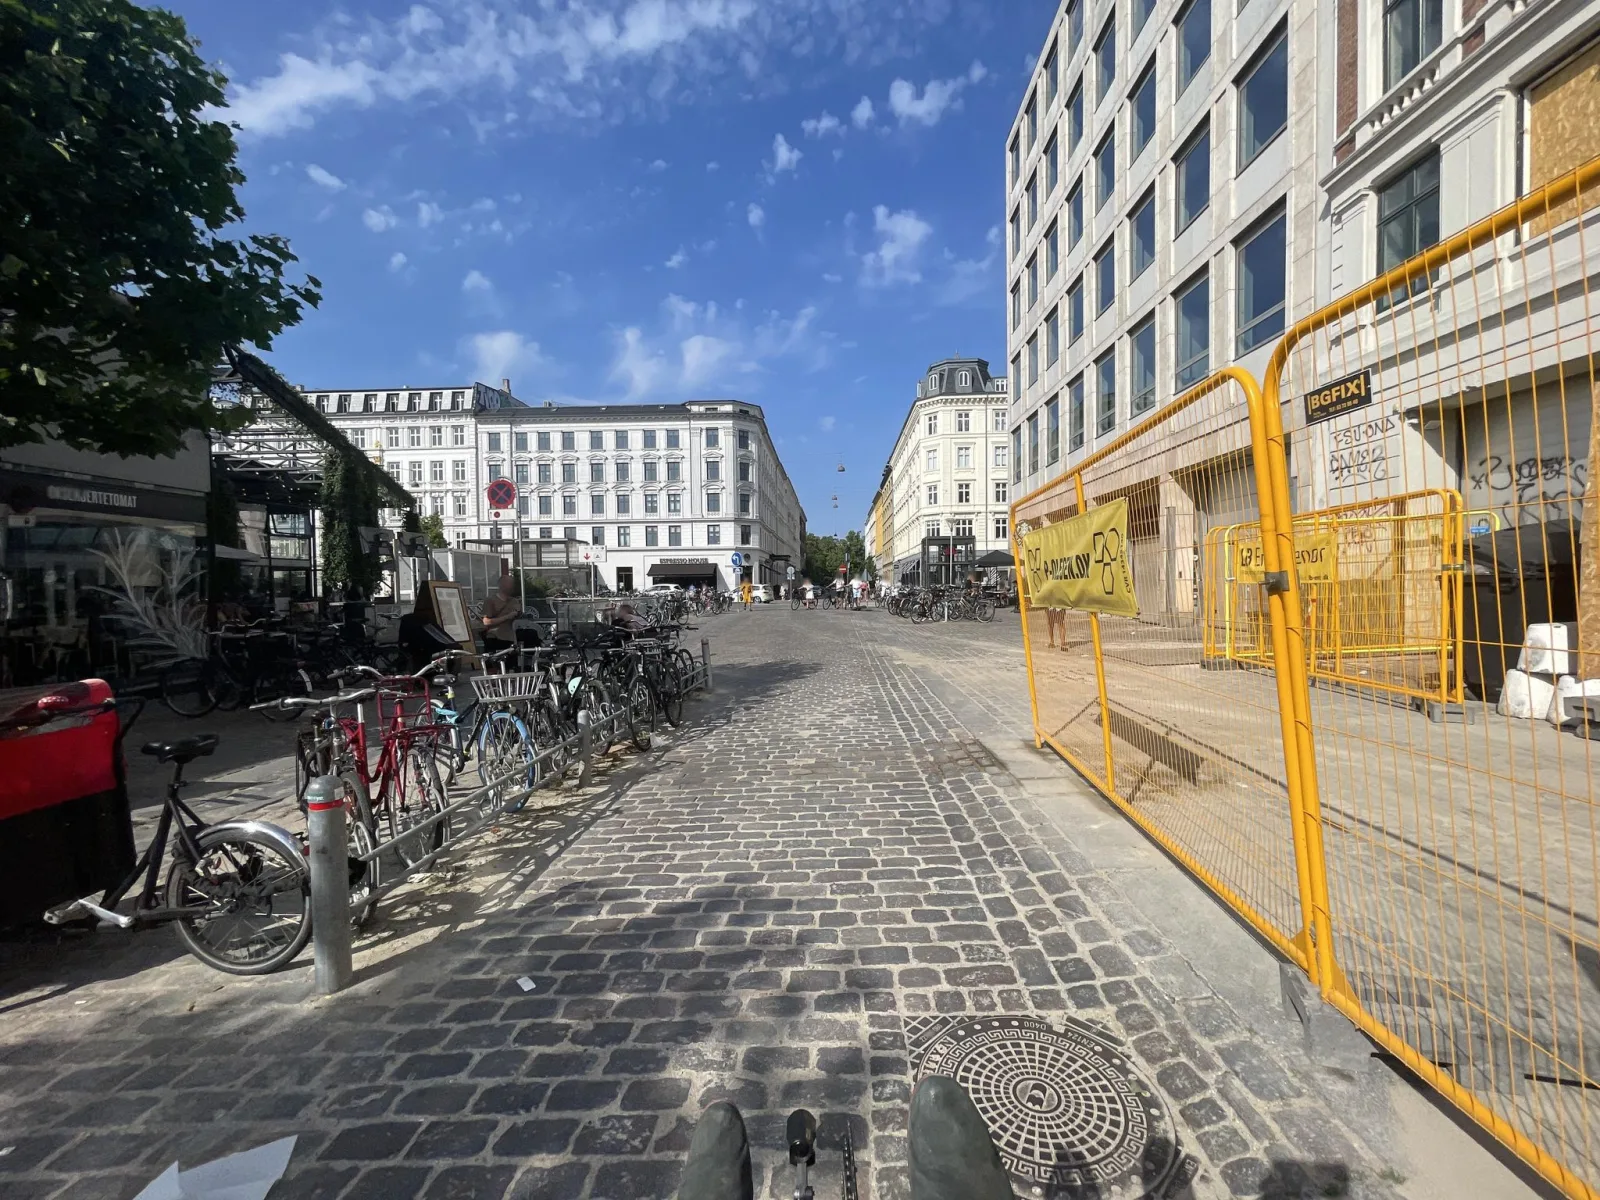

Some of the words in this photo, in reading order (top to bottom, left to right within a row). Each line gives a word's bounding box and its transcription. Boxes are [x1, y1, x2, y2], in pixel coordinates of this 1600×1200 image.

[1309, 376, 1363, 411] BGFIX
[1023, 1020, 1047, 1030] D400
[1066, 1030, 1096, 1049] EN124
